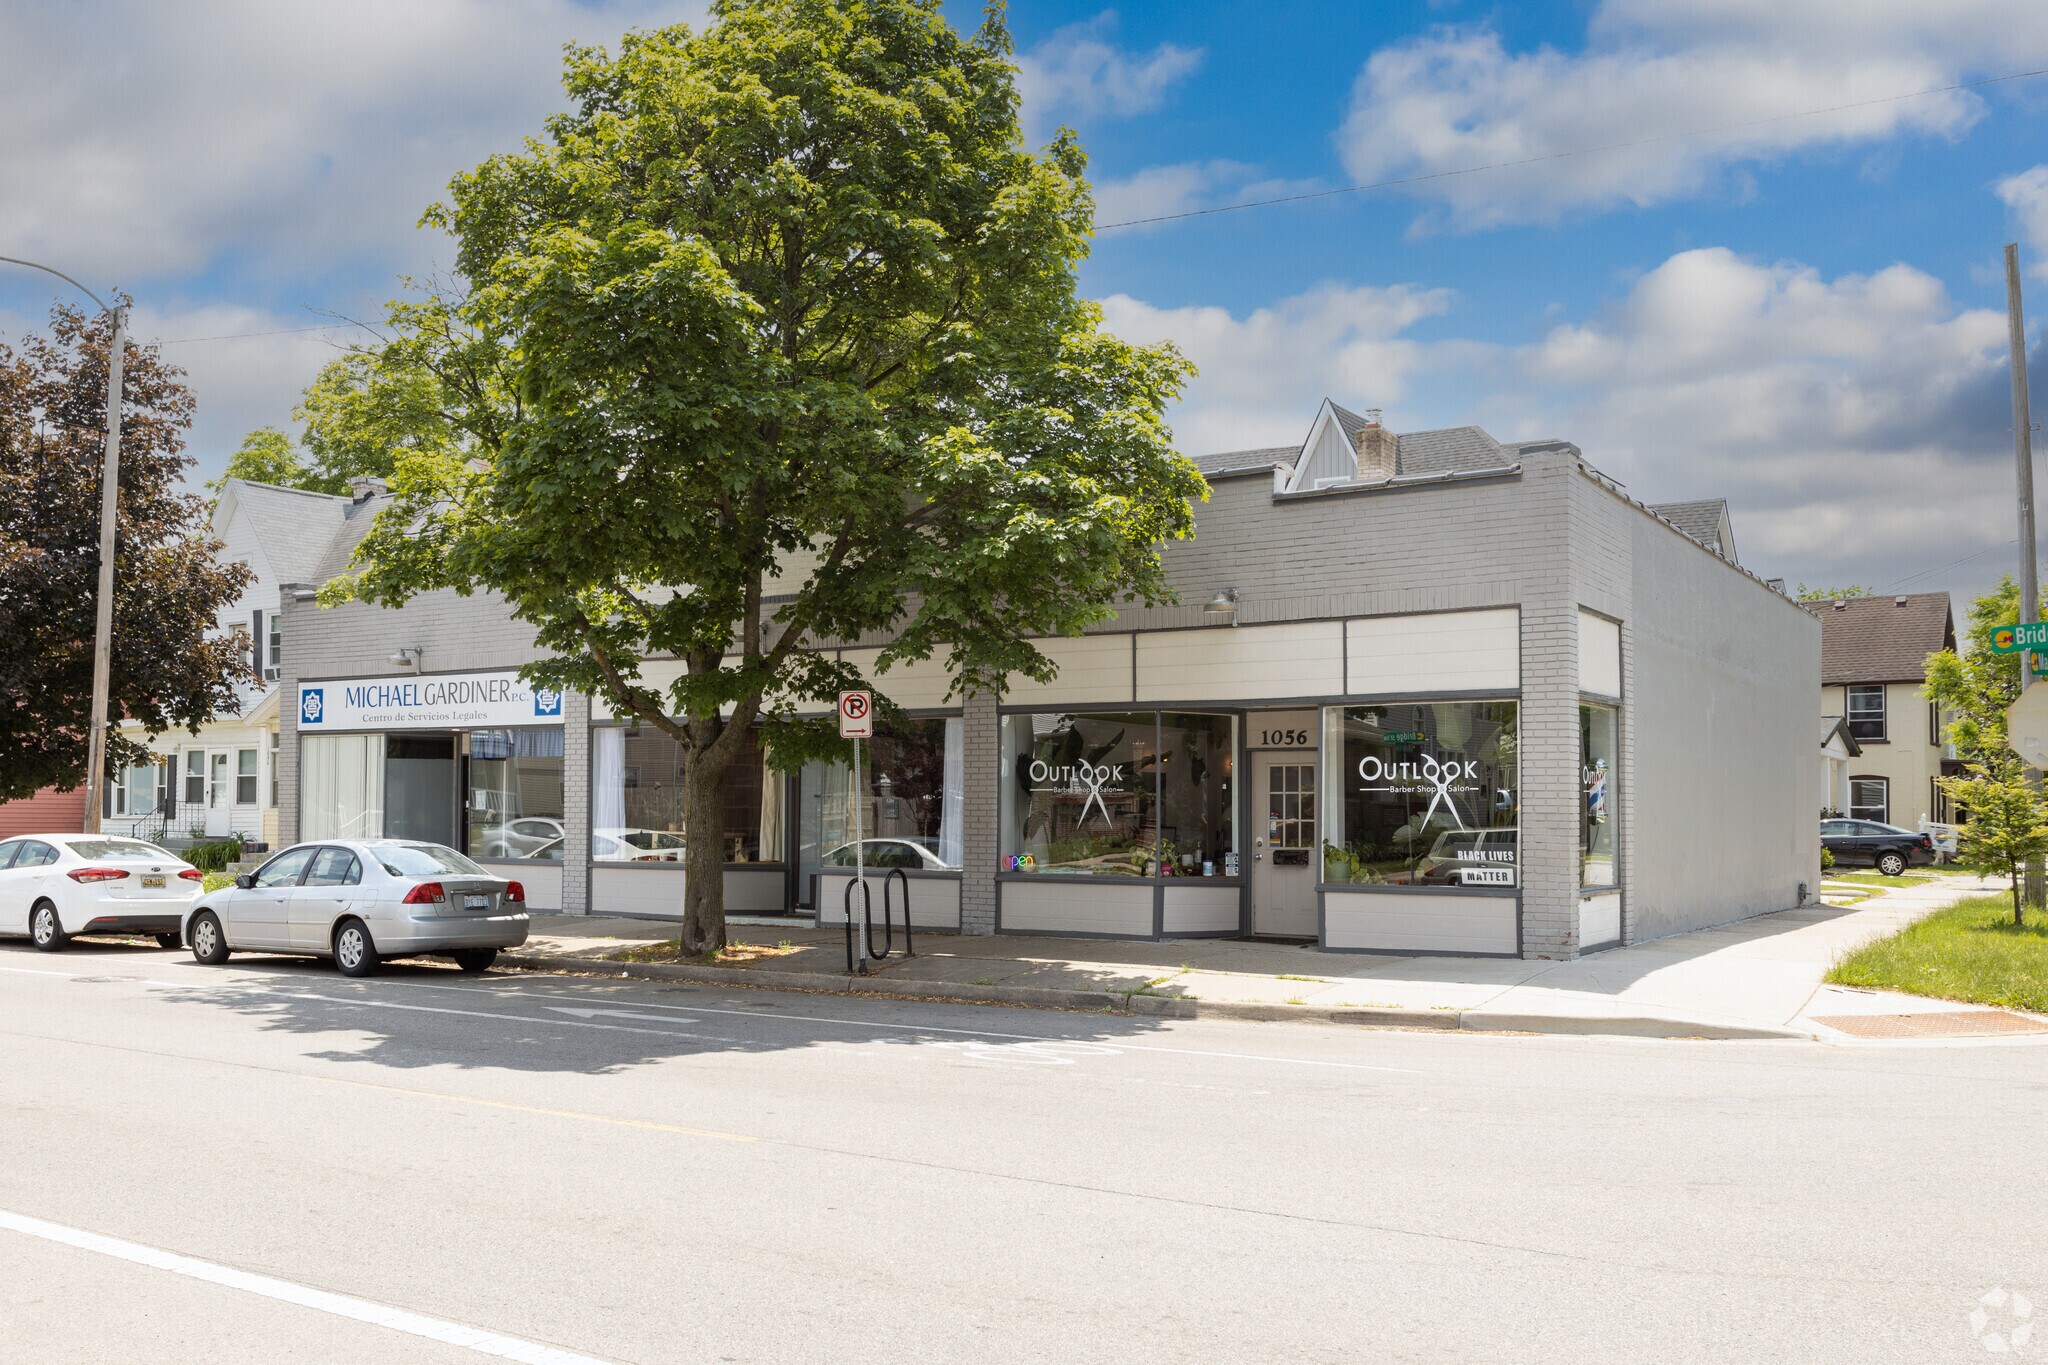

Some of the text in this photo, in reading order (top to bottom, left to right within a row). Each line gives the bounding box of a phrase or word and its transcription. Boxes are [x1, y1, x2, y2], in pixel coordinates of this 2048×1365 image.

[2015, 625, 2048, 645] Brid
[345, 679, 529, 708] MICHAEL GARDINER P.C.
[362, 710, 488, 723] Centro de Servicios Legales
[1261, 729, 1308, 745] 1056
[1029, 758, 1124, 783] OUTLOOK
[1358, 754, 1478, 781] OUTLOOK
[1074, 786, 1090, 794] Shop
[1099, 785, 1117, 793] Salon
[1389, 785, 1415, 794] Barber
[1416, 785, 1437, 795] Shop
[1447, 785, 1470, 793] Salon
[1002, 855, 1035, 870] open
[1457, 850, 1515, 862] BLACK LIVES
[1466, 871, 1509, 882] MATTER
